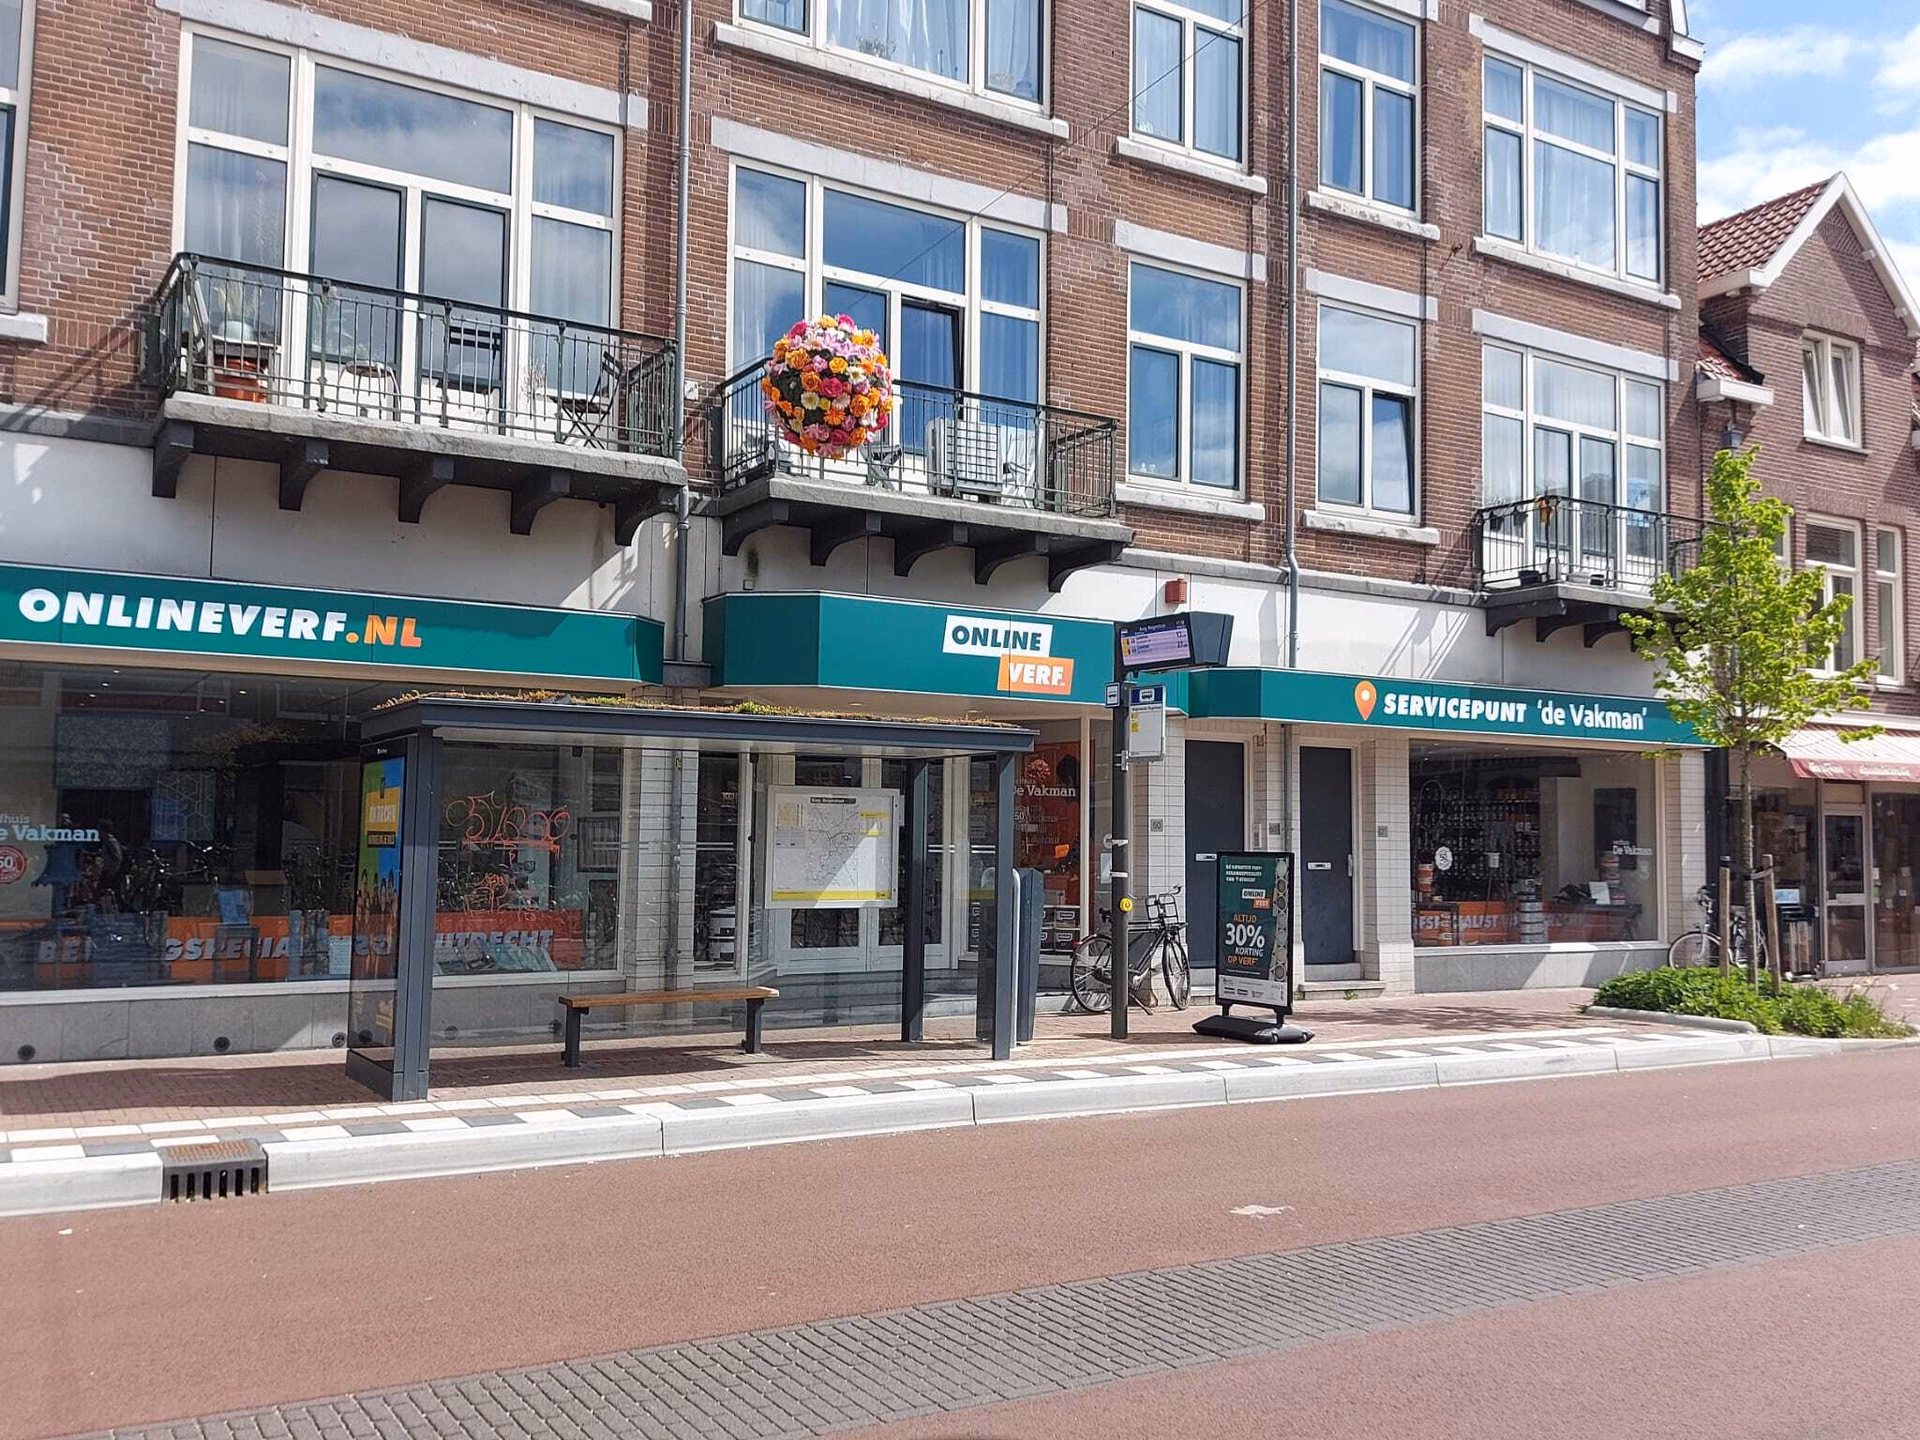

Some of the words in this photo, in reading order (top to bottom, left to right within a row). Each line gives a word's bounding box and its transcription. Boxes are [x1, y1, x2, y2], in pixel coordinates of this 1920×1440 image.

[18, 588, 423, 648] ONLINEVERF.NL
[951, 624, 1043, 652] ONLINE
[1383, 693, 1527, 723] SERVICEPUNT
[1026, 784, 1077, 797] Vakman
[12, 824, 101, 842] Vakman
[1234, 914, 1257, 923] ALTIJD
[1225, 923, 1265, 948] 30%
[1228, 955, 1237, 965] OP
[1235, 947, 1264, 957] KORTING
